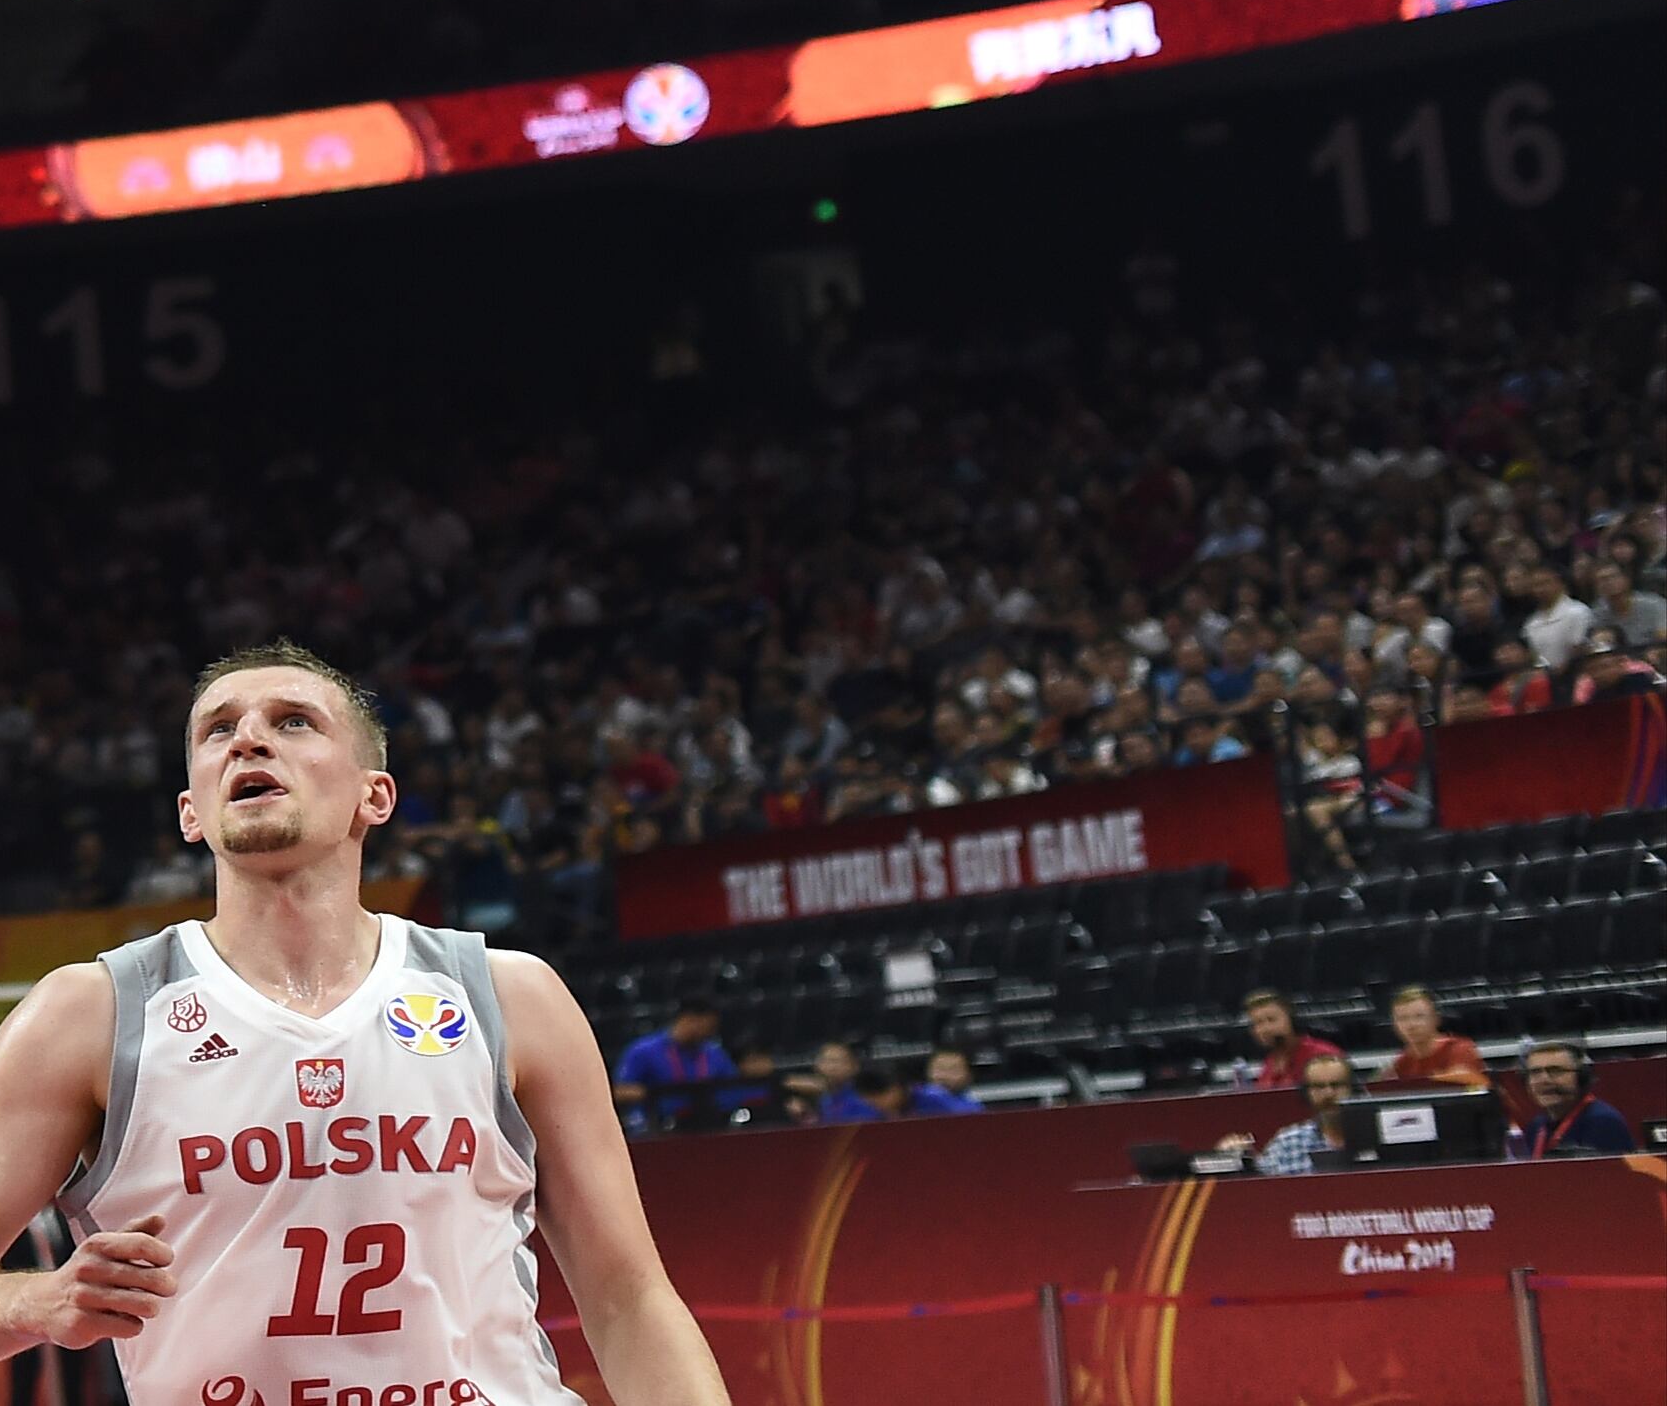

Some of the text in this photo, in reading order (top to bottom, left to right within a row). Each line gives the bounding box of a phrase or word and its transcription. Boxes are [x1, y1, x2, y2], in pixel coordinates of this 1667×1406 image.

[1312, 81, 1565, 242] 116
[723, 808, 1148, 923] THE WORLD'S GOT GAME
[178, 1113, 477, 1195] POLSKA
[267, 1222, 406, 1337] 12
